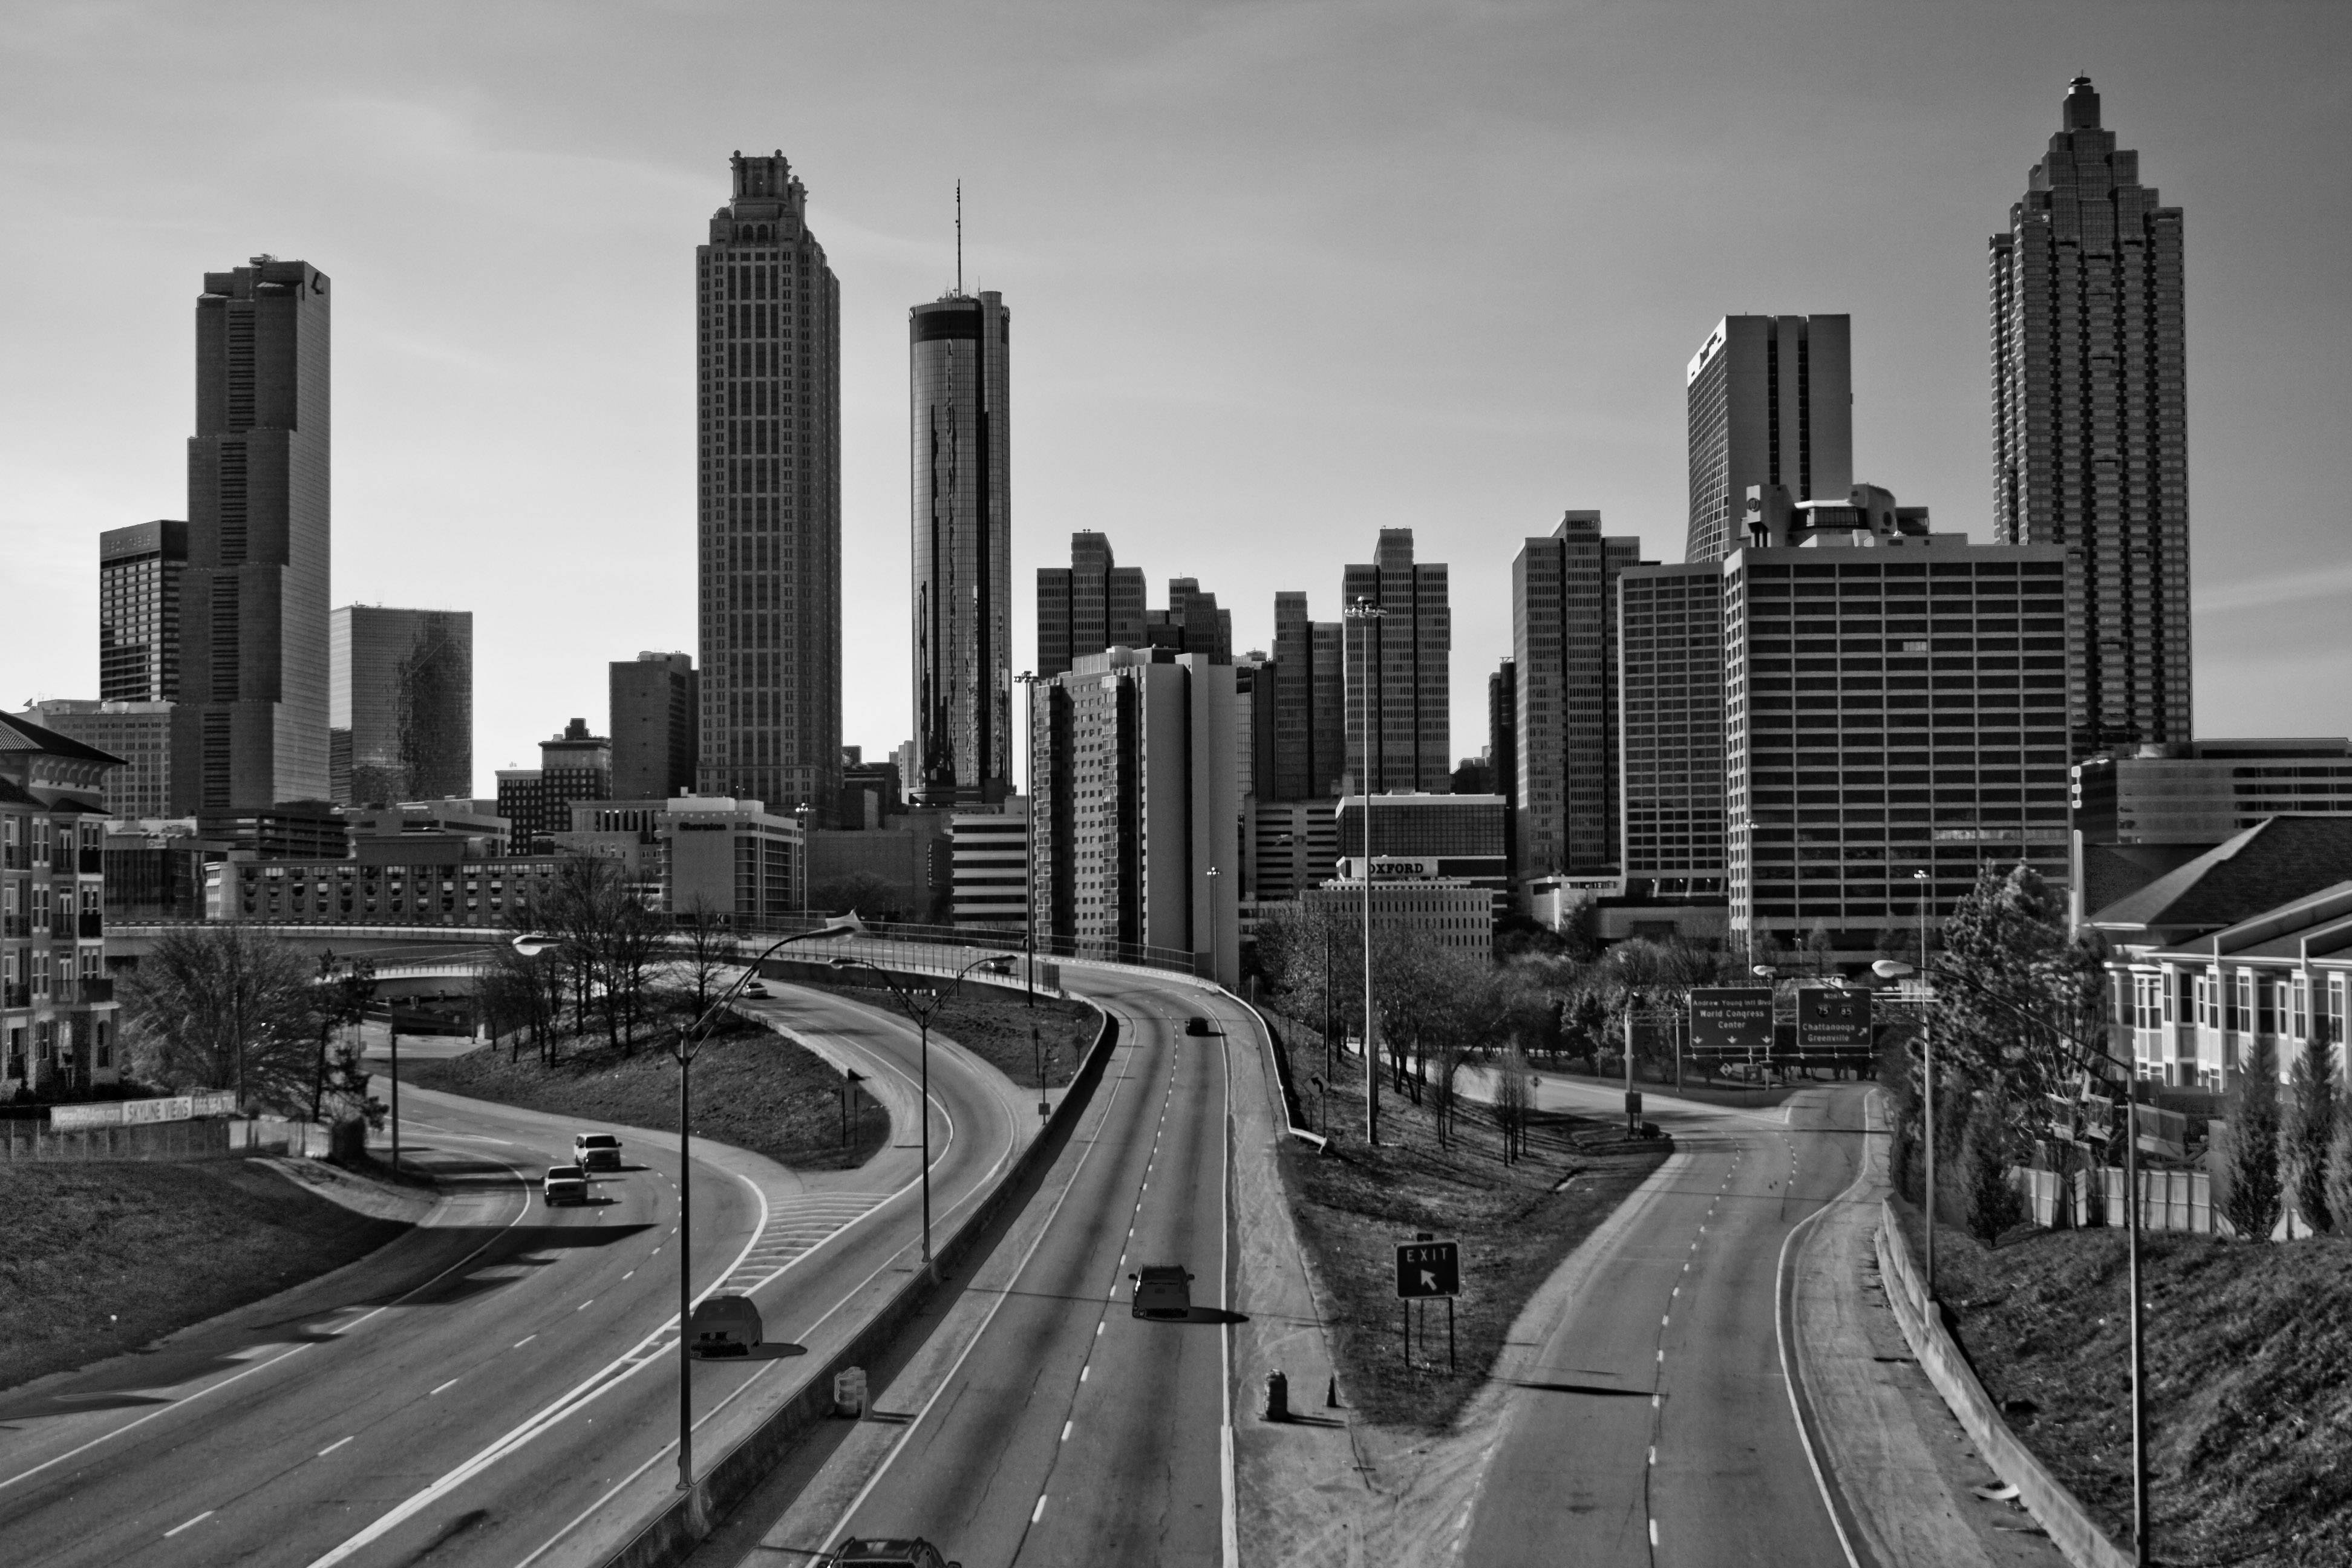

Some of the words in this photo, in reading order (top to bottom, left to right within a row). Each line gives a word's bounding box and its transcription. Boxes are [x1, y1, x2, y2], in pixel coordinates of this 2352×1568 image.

[1726, 1010, 1765, 1019] Congress
[1802, 1023, 1855, 1032] Chattanooga
[1406, 1247, 1448, 1263] EXIT
